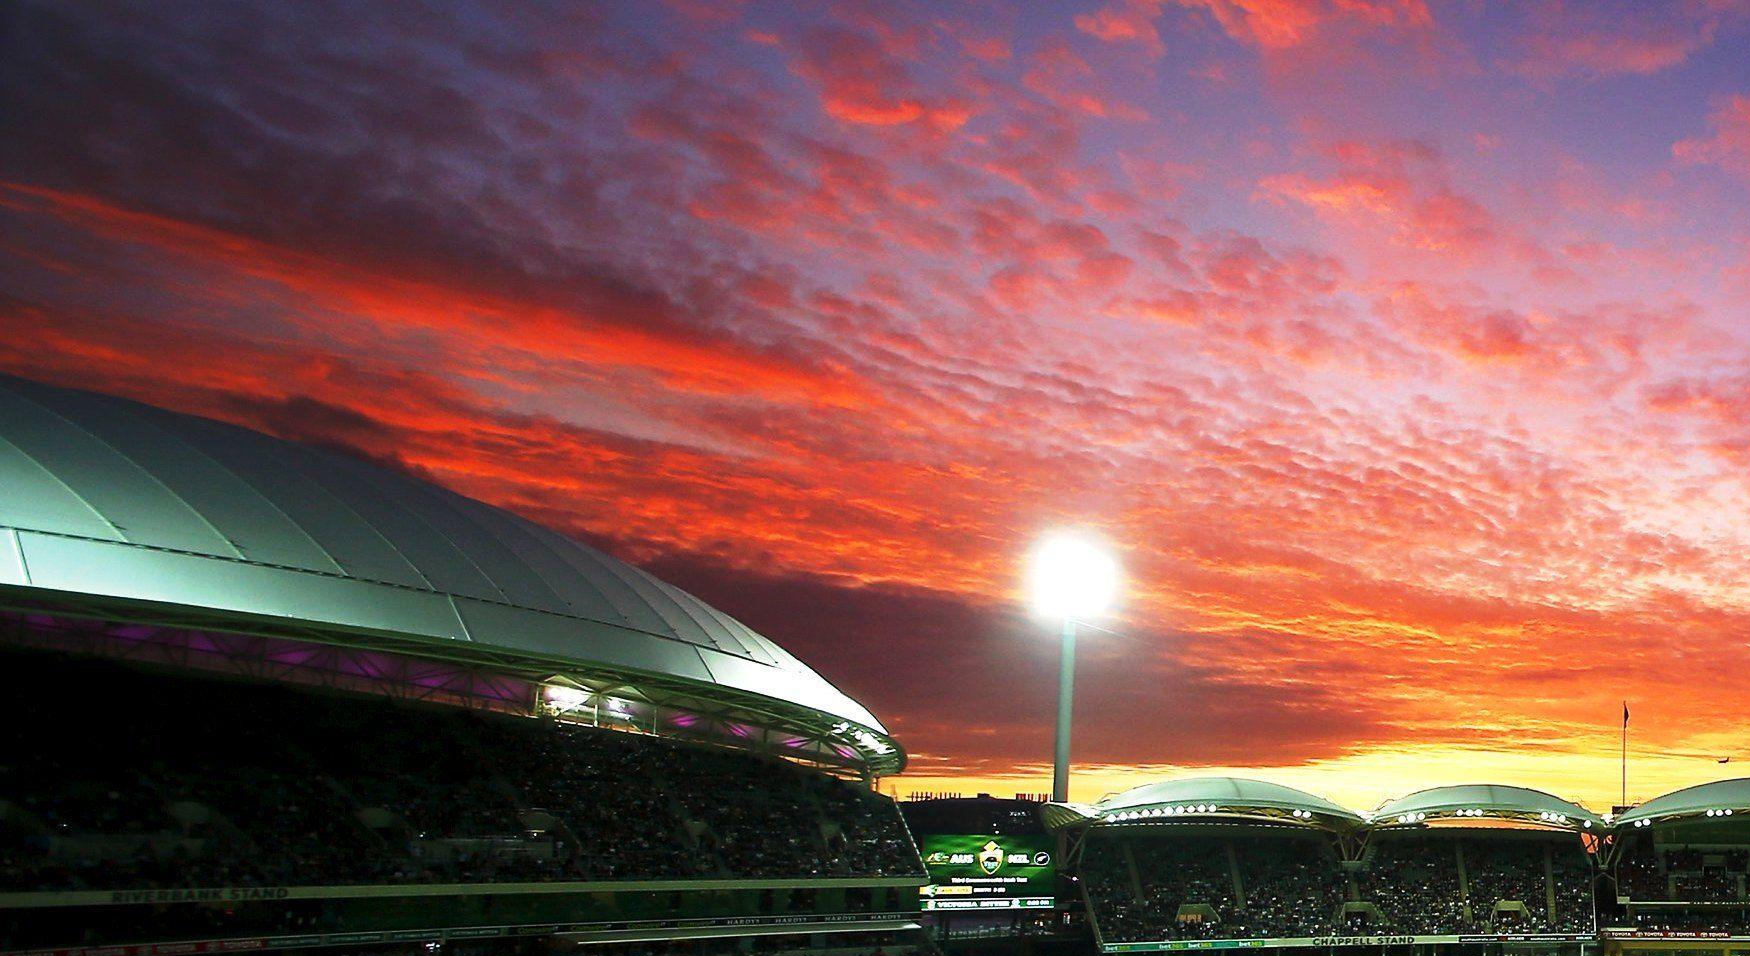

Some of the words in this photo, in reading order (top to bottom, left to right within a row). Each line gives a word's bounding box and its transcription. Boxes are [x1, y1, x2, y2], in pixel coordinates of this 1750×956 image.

[950, 854, 974, 864] AUS
[1312, 937, 1373, 946] CHAPPELL
[1377, 936, 1415, 945] STAND
